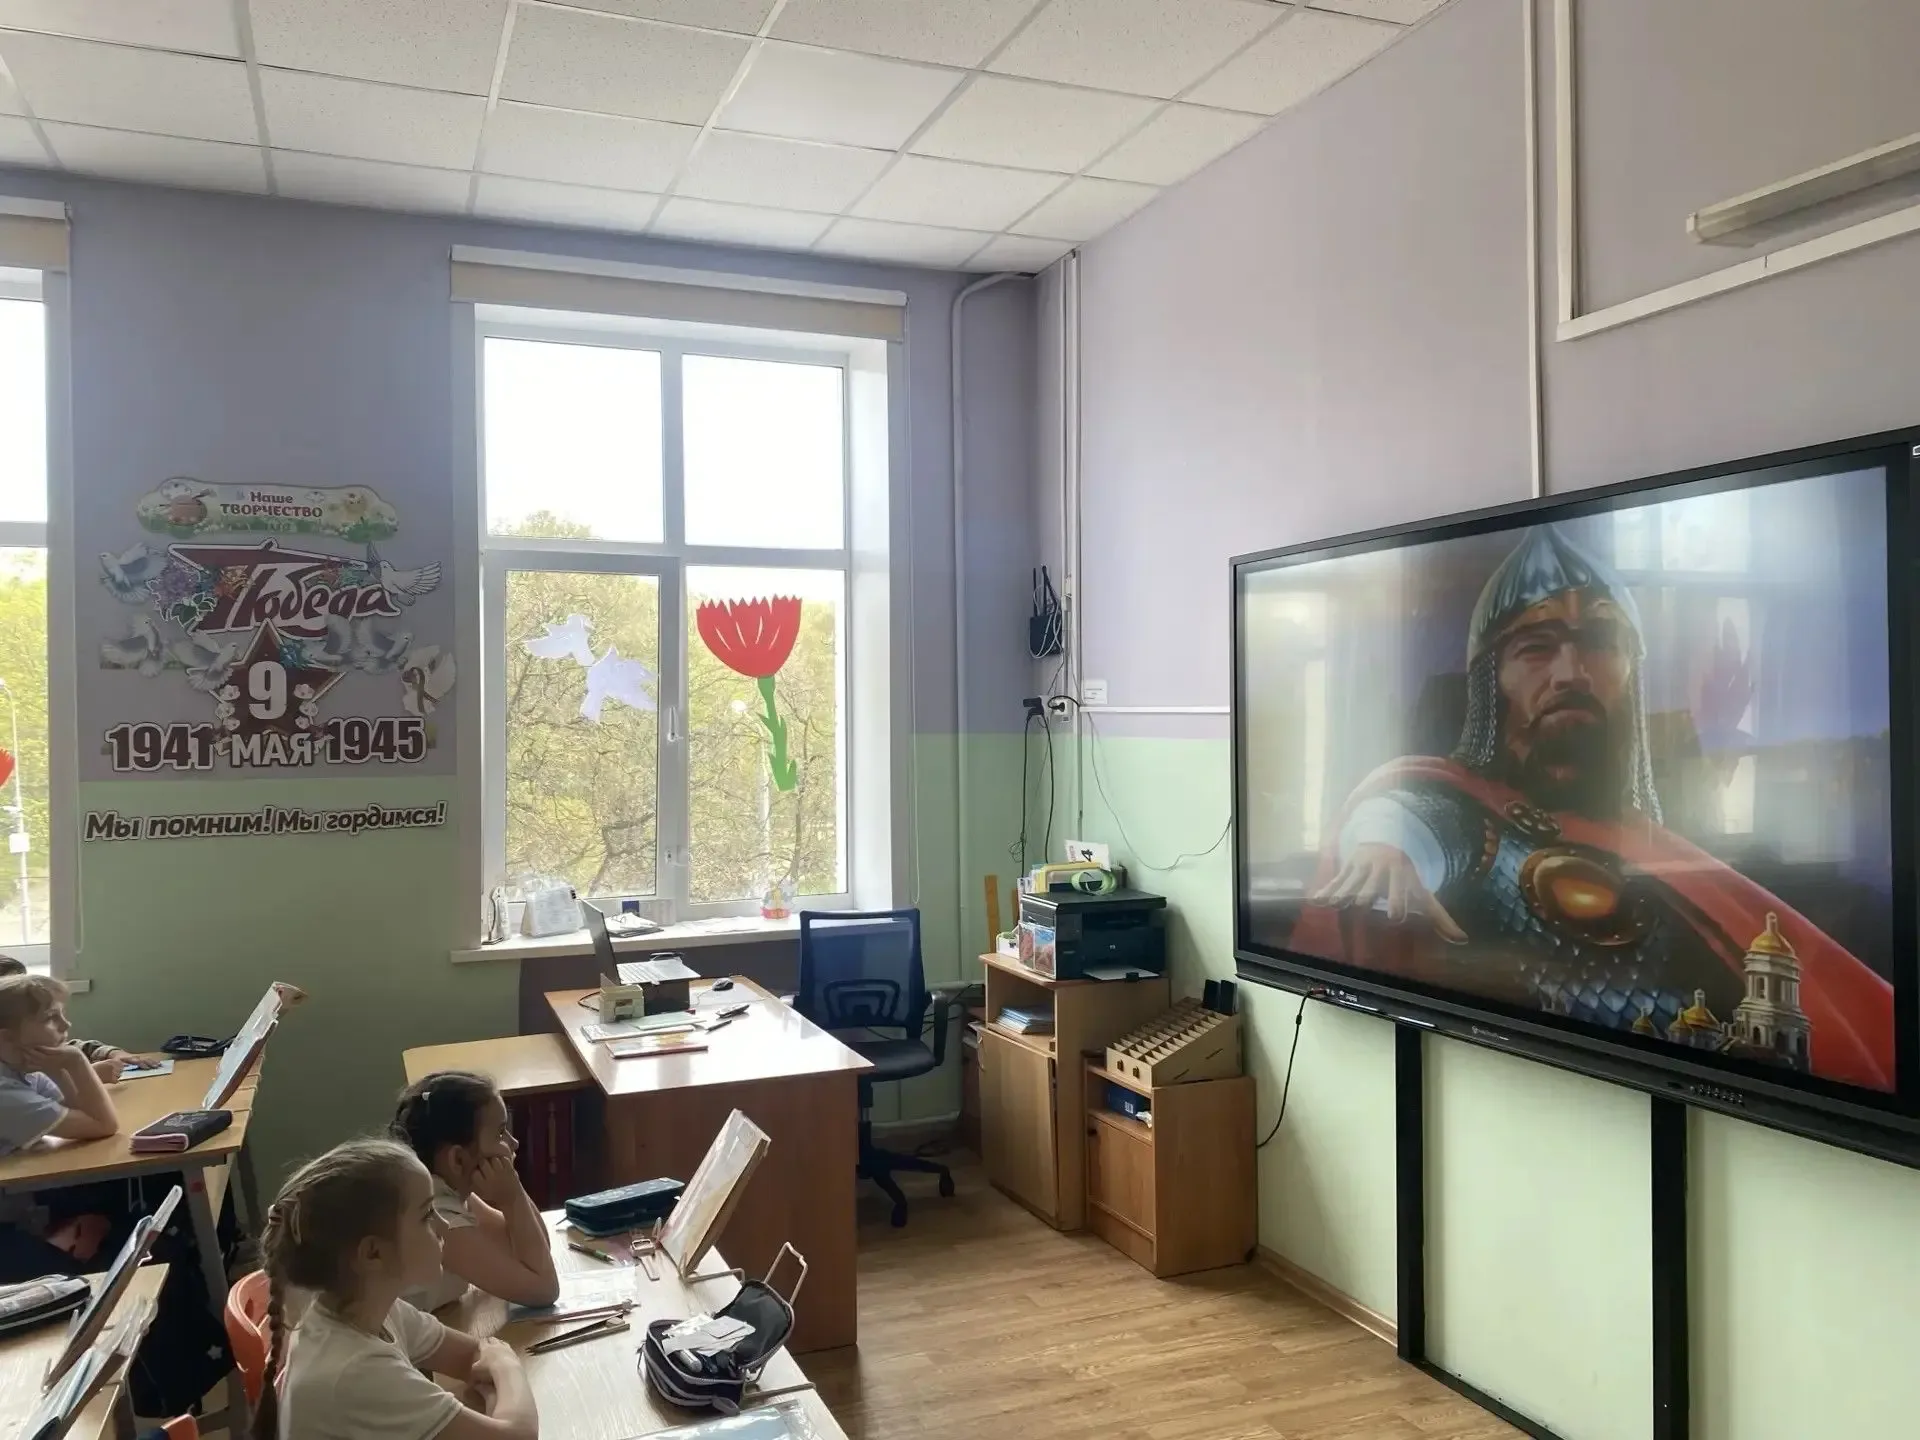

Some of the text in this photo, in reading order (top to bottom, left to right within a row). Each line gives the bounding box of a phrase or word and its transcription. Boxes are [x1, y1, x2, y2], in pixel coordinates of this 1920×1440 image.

[220, 503, 323, 518] ТВОРЧЕСТВО
[250, 491, 294, 504] Наше
[249, 660, 288, 720] 9
[105, 717, 427, 771] 1941 МАЯ 1945
[85, 802, 446, 840] Мы помним! Мы гордимся!
